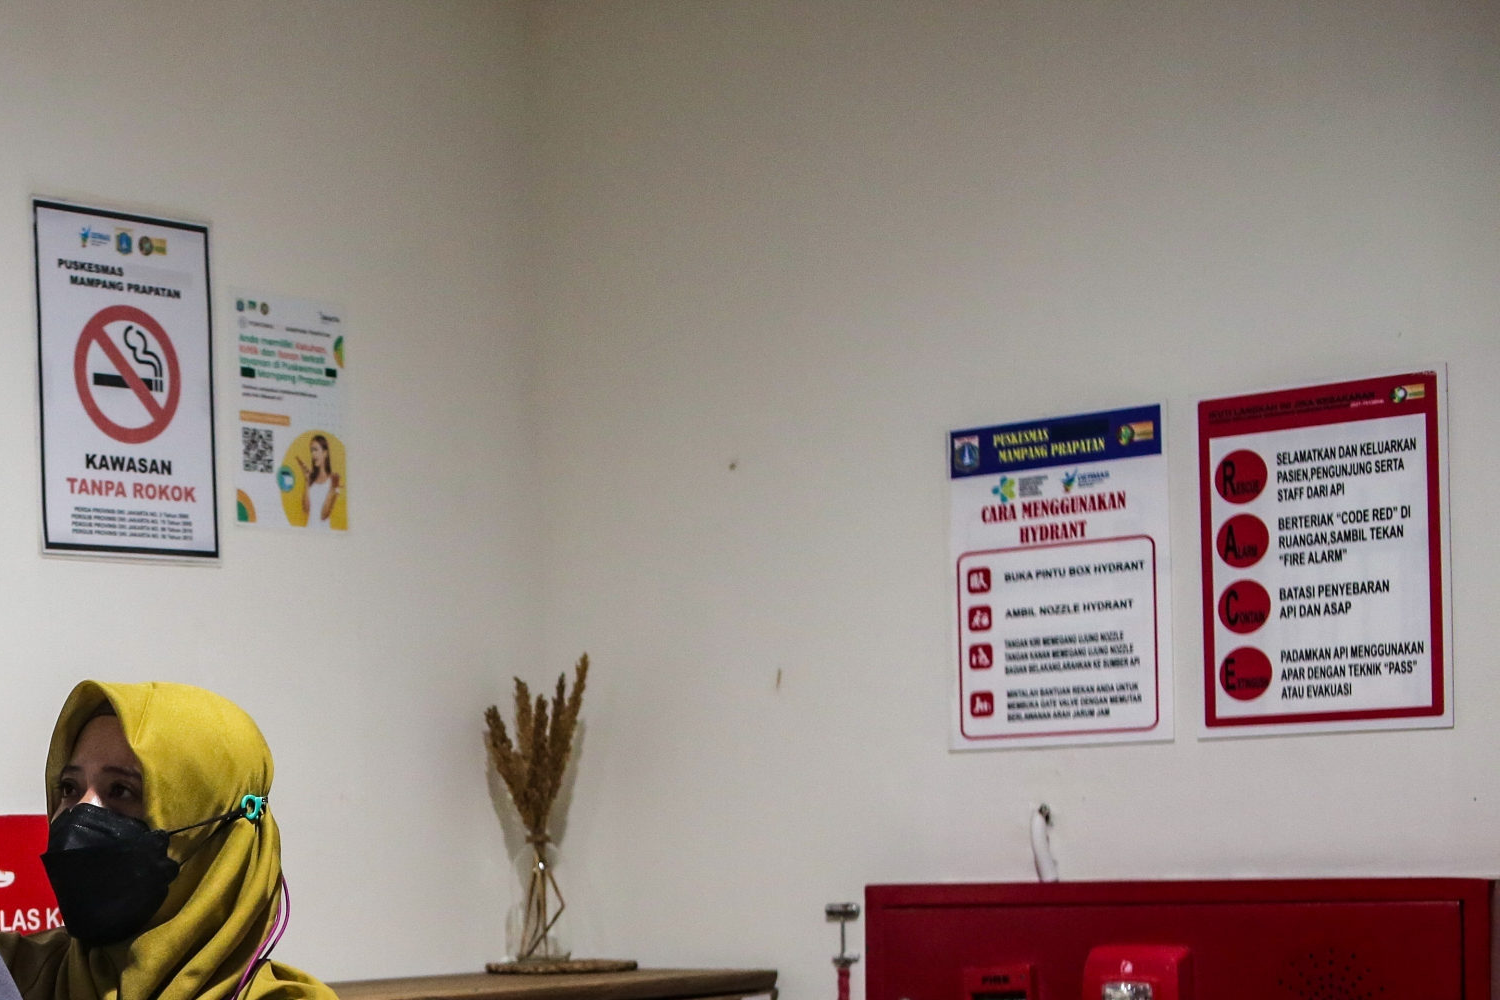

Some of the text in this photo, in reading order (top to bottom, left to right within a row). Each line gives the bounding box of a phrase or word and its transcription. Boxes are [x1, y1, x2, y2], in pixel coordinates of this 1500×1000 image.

[58, 258, 124, 277] PUSKESMAS
[70, 275, 181, 299] MAMPANG PRAPATAN
[1277, 438, 1416, 465] SELAMATKAN DAN KELUARKAN
[85, 453, 172, 476] KAWASAN
[1375, 458, 1404, 472] SERTA
[67, 477, 196, 502] TANPA ROKOK
[1278, 484, 1344, 502] STAFF DARI API
[981, 491, 1126, 524] CARA MENGGUNAKAN
[1278, 512, 1334, 531] BERTERIAK
[1401, 506, 1411, 518] DI
[1020, 521, 1087, 543] HYDRANT
[1370, 525, 1404, 540] TEKAN
[1280, 580, 1390, 601] BATASI PENYEBARAN
[1280, 602, 1351, 619] API DAN ASAP
[1281, 641, 1424, 663] PADAMKAN API MENGGUNAKAN
[1281, 667, 1305, 681] APAR
[1308, 664, 1345, 679] DENGAN
[1348, 662, 1381, 676] TEKNIK
[1282, 683, 1351, 700] ATAU EVAKUASI
